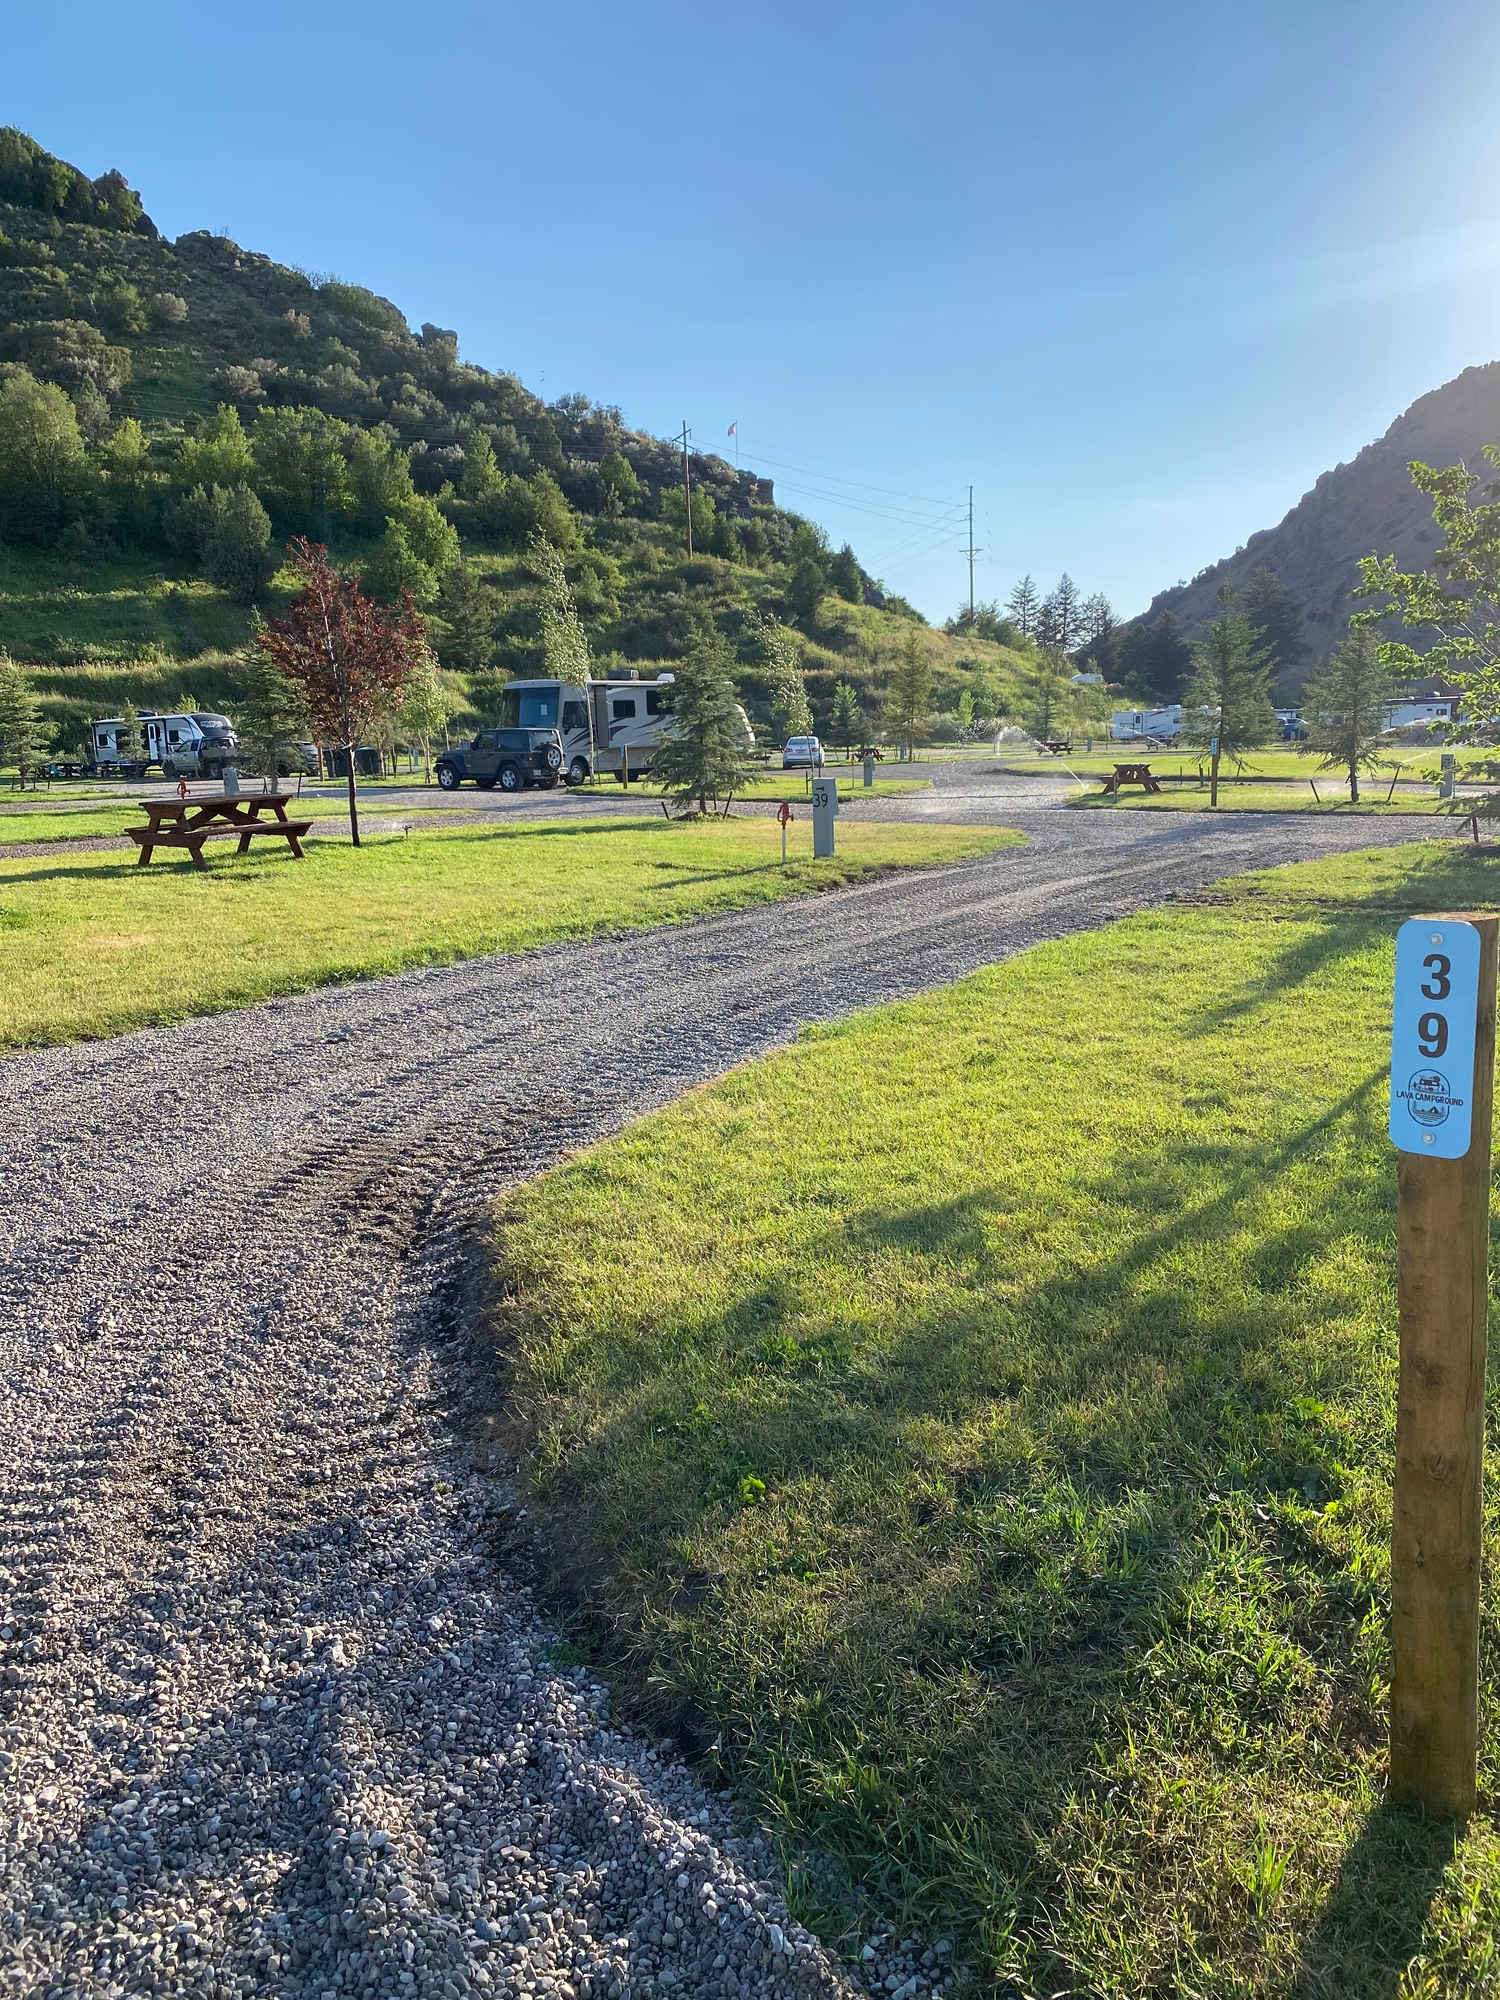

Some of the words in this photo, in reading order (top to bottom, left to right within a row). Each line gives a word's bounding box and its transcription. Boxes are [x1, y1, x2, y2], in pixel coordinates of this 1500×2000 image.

[813, 793, 828, 808] 39
[1396, 1090, 1414, 1099] LAVA
[1415, 1093, 1463, 1105] CAMPGROUND
